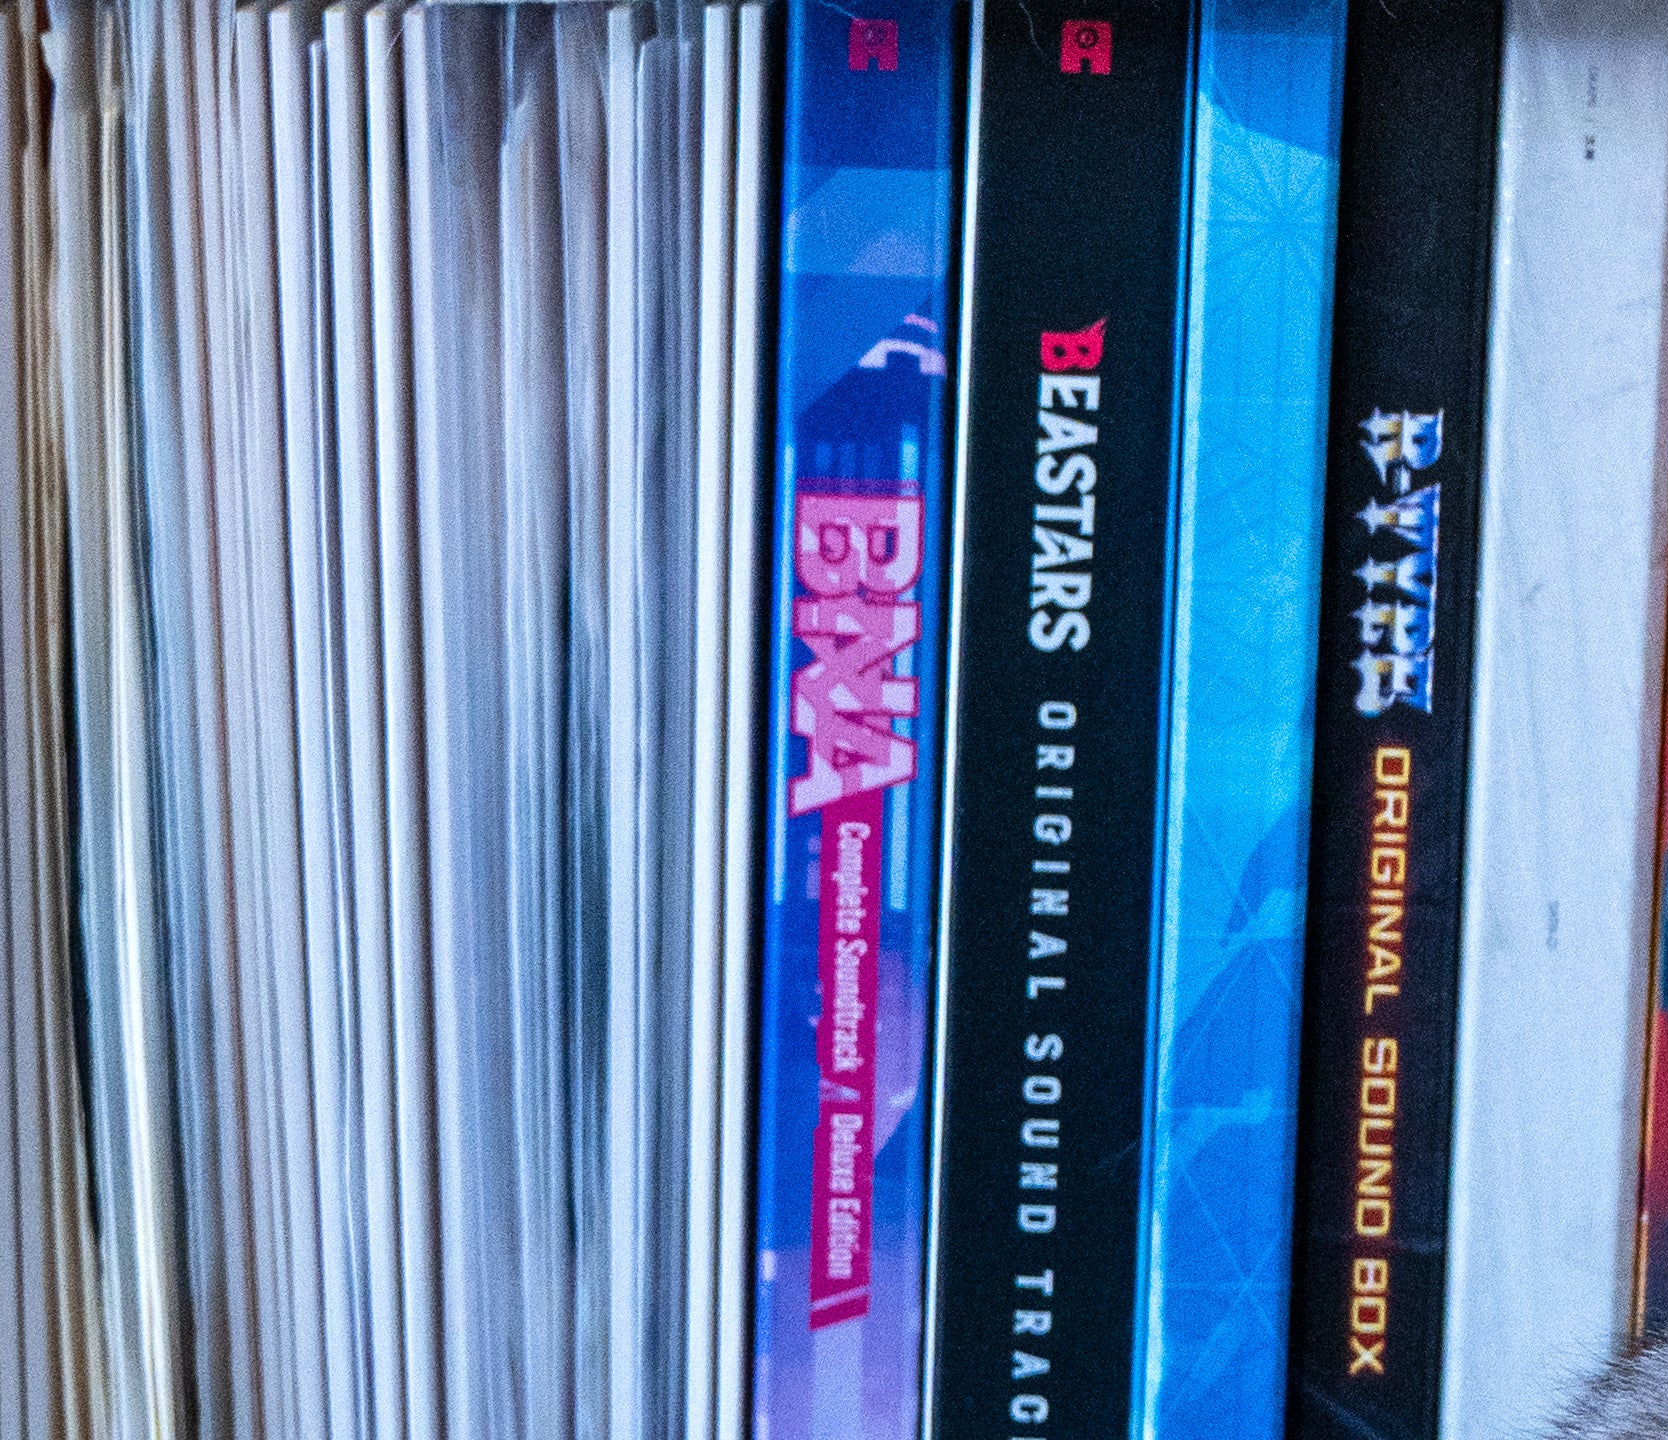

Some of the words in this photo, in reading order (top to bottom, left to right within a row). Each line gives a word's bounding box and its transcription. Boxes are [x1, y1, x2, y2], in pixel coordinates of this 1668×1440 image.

[1027, 318, 1104, 653] BEASTARS
[1350, 409, 1446, 717] R-TYPE
[788, 491, 926, 818] BNA
[831, 820, 872, 933] Complete
[1026, 700, 1078, 1001] ORIGINAL
[1363, 746, 1413, 1015] ORIGINAL
[831, 939, 869, 1072] Soundtrack
[827, 1113, 864, 1192] Deluxe
[1014, 1033, 1066, 1234] SOUND
[1355, 1038, 1399, 1236] SOUND
[826, 1196, 860, 1280] Edition
[1348, 1259, 1388, 1377] BOX
